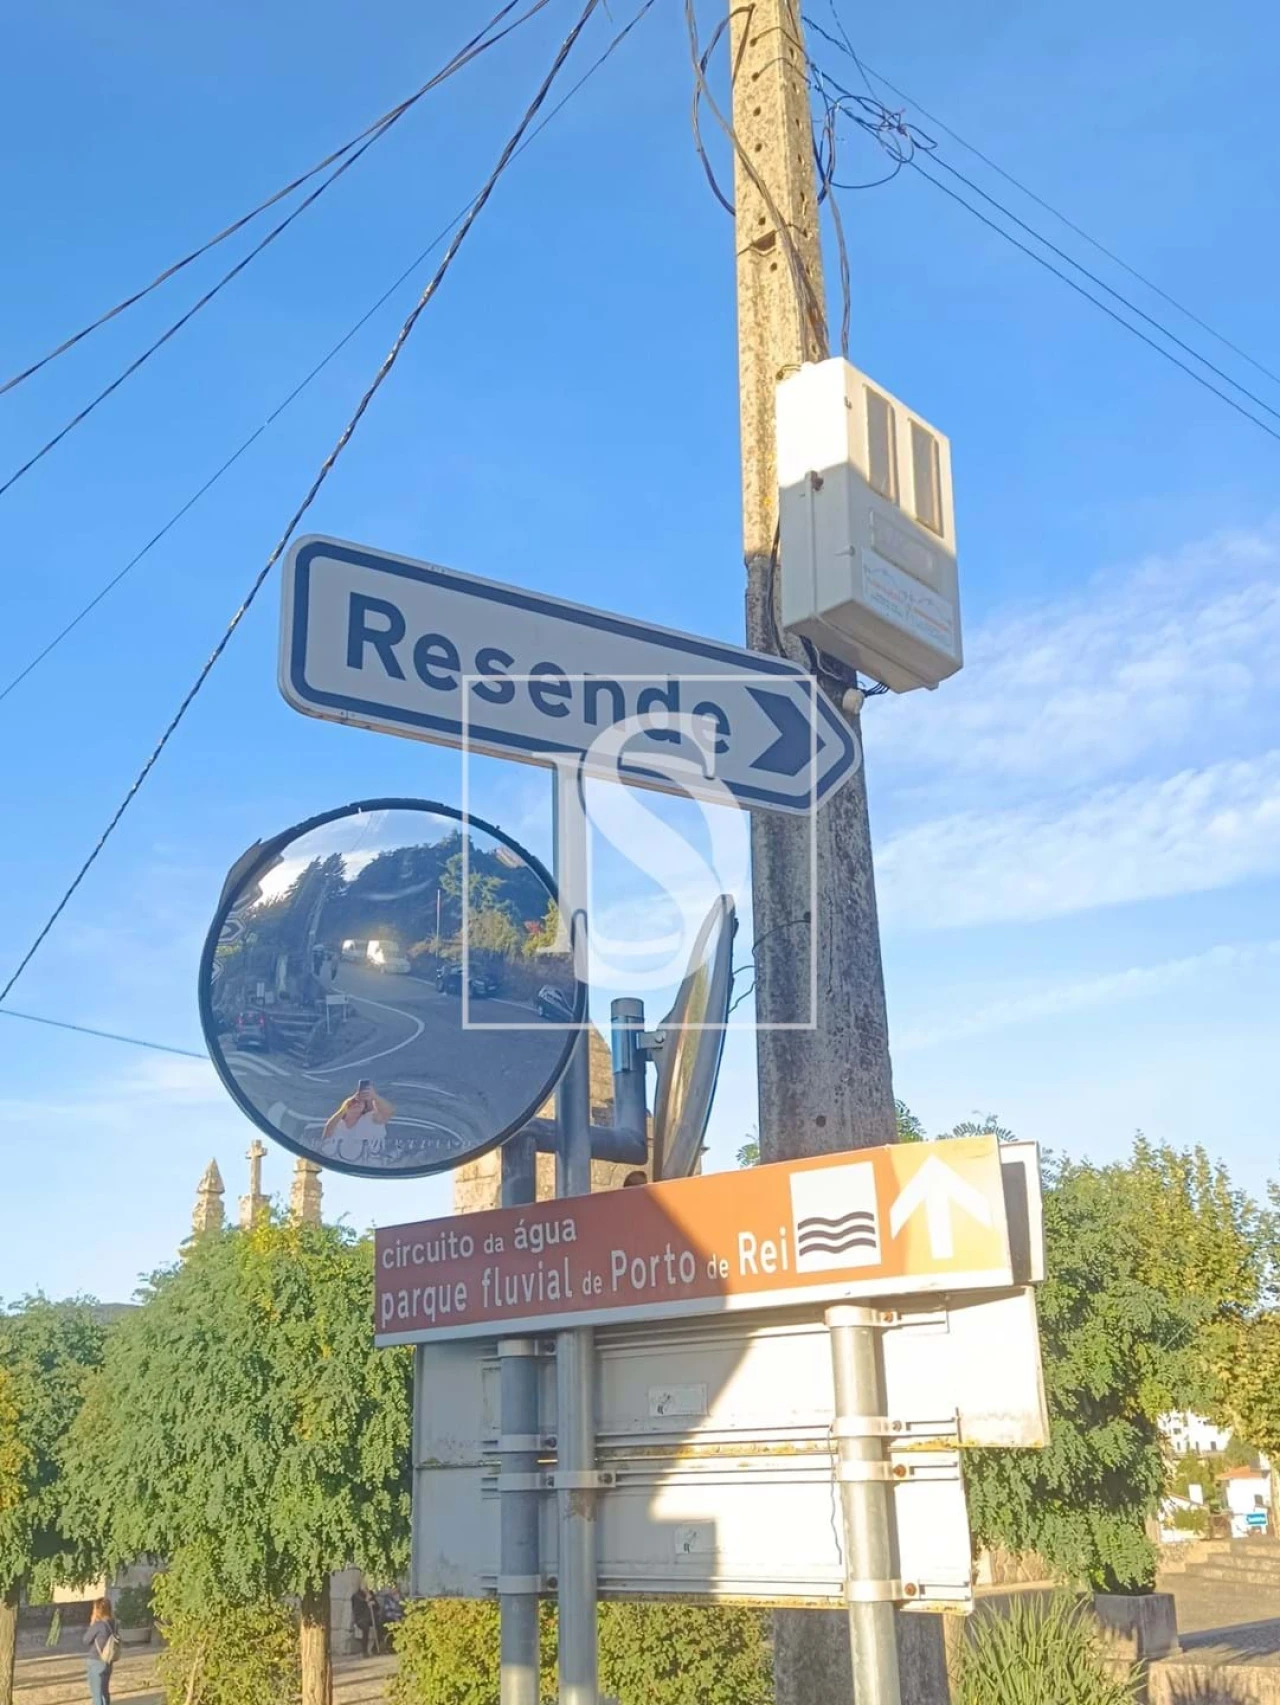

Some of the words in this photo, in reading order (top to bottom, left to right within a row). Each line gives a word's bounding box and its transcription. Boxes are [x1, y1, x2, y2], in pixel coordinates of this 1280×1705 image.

[347, 592, 730, 753] Resende
[381, 1282, 467, 1329] parque
[482, 1256, 573, 1308] fluvial
[582, 1270, 602, 1295] de
[611, 1243, 695, 1292] Porto
[707, 1254, 729, 1279] de
[738, 1226, 788, 1276] Rei
[382, 1224, 474, 1269] circuito
[483, 1234, 504, 1254] da
[514, 1218, 576, 1253] água
